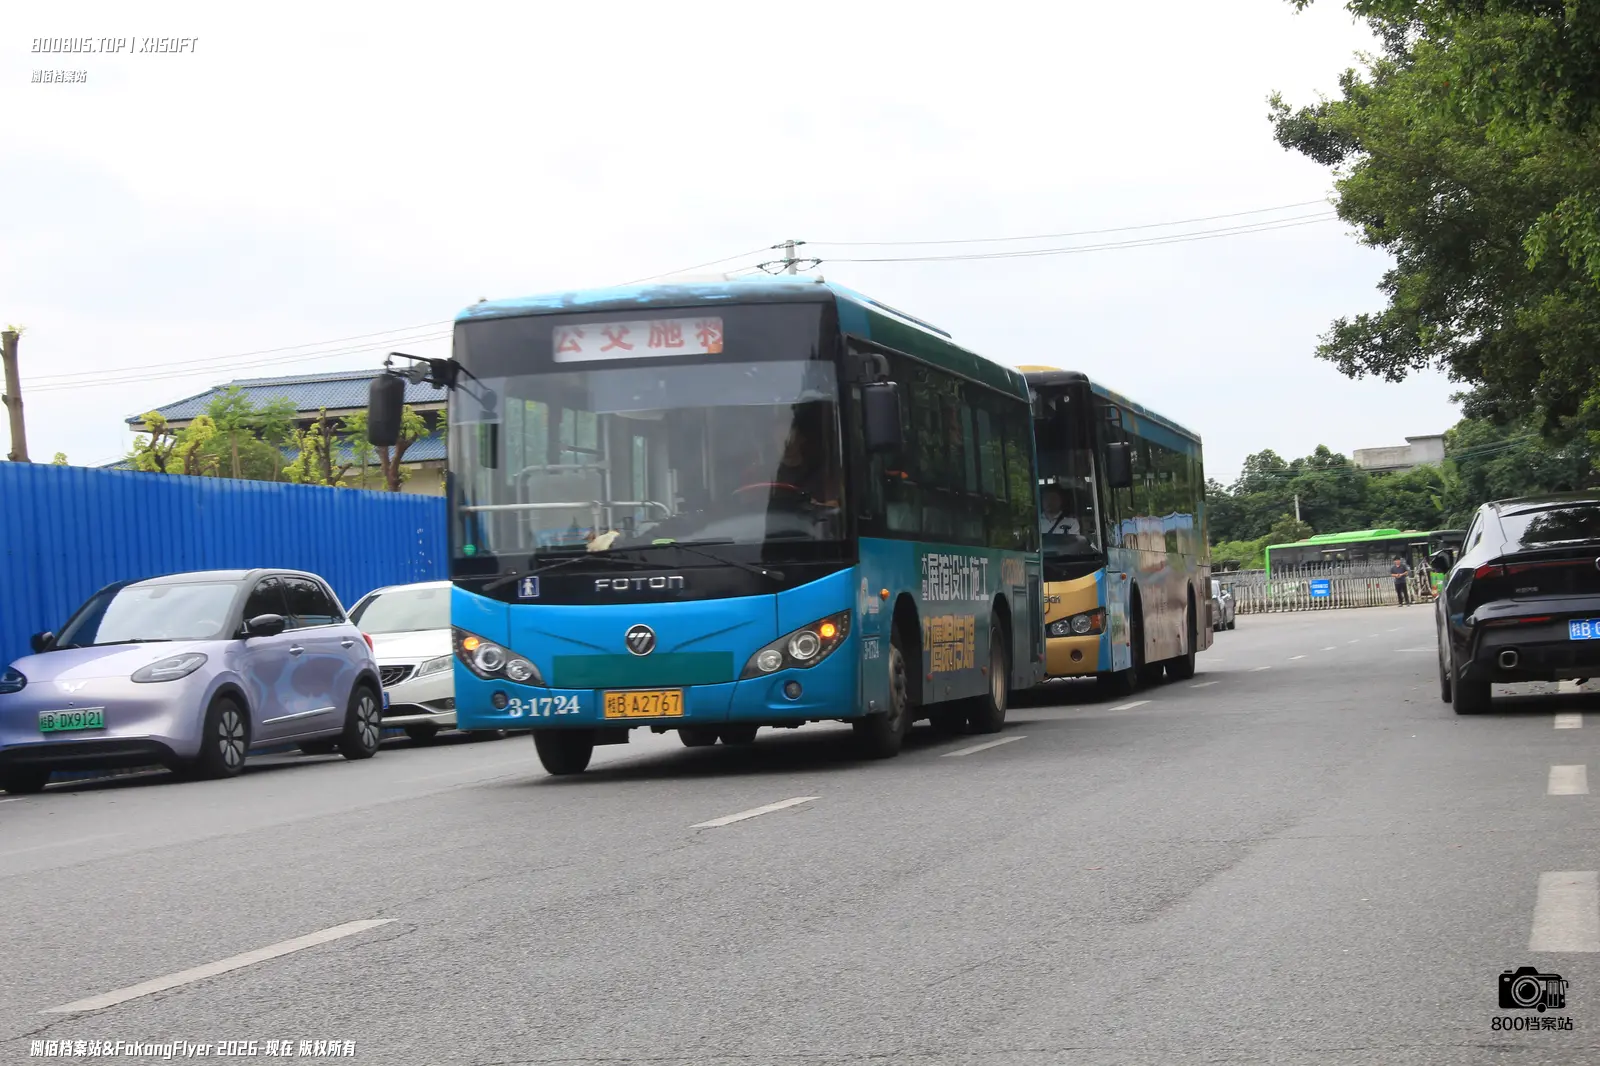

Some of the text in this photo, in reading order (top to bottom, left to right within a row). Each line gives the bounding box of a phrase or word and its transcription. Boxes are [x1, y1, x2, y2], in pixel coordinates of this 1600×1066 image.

[594, 575, 684, 592] FOTON
[928, 553, 990, 601] 展馆设计施工
[508, 695, 581, 717] 3-1724
